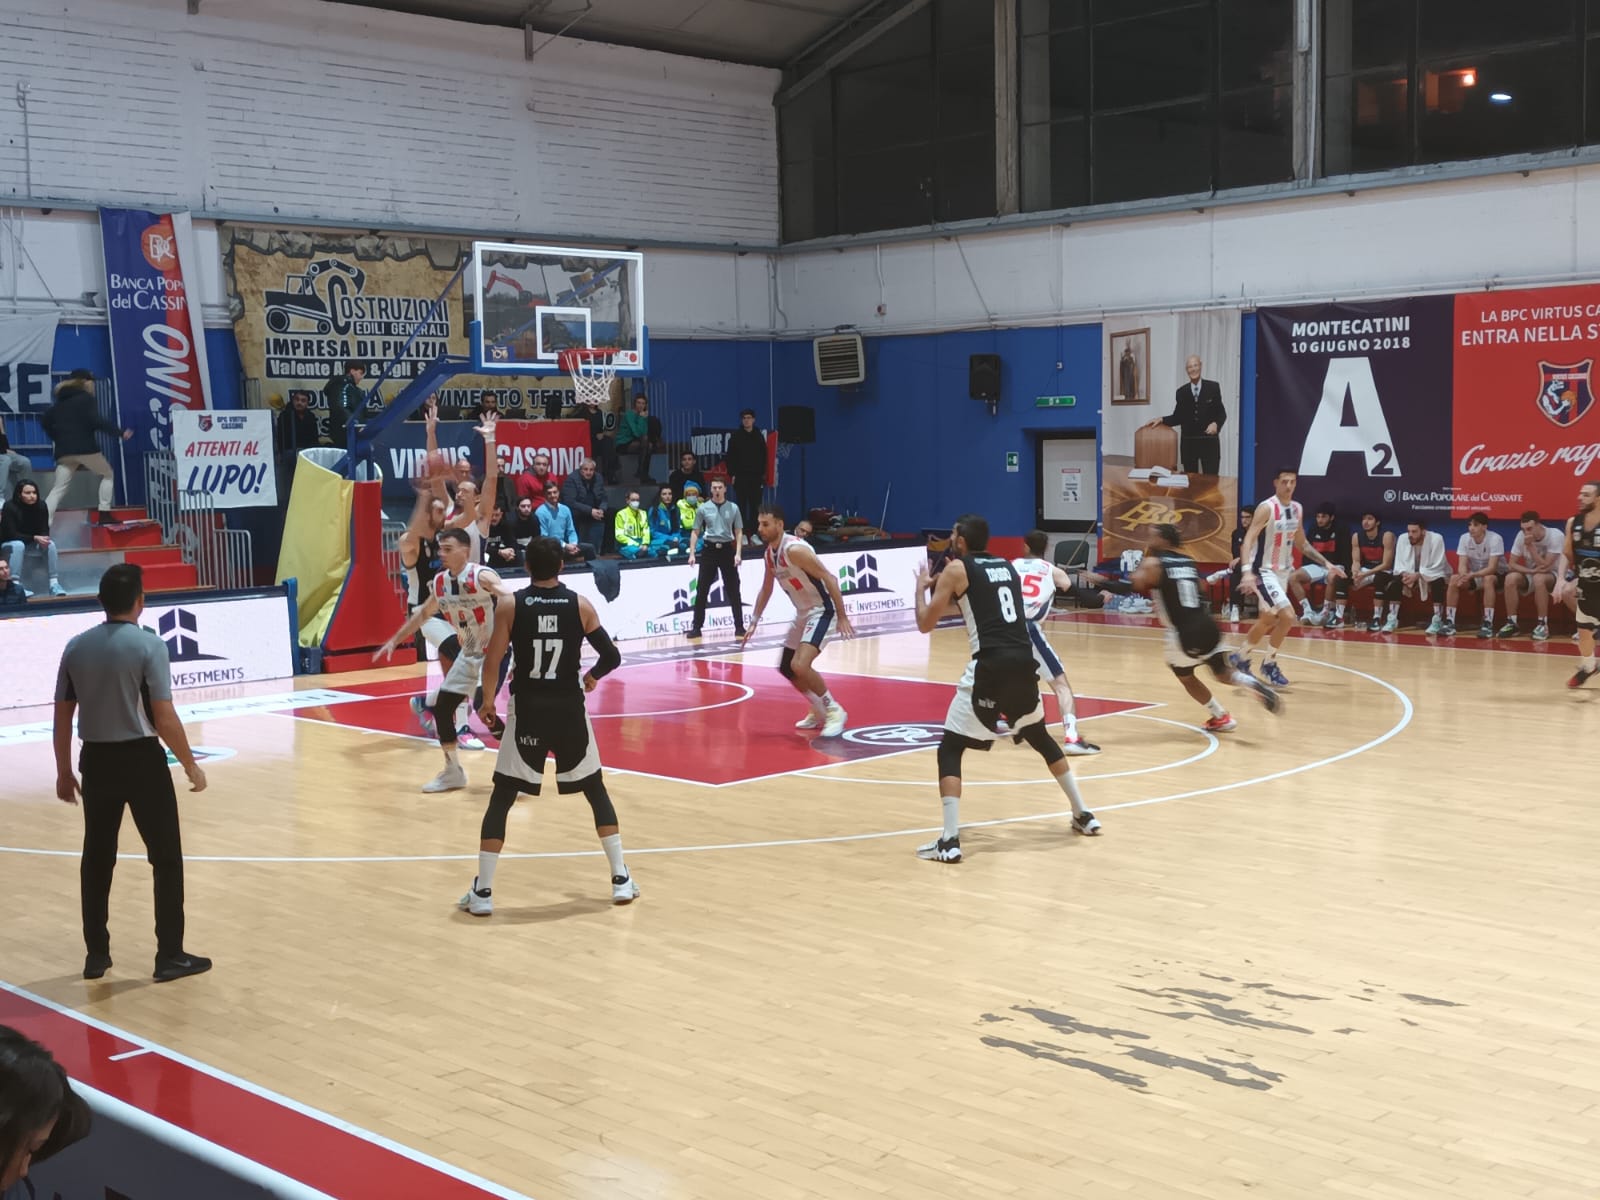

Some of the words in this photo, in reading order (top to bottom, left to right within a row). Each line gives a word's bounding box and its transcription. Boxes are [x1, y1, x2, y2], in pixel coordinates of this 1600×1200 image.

[110, 274, 154, 290] BANCA
[157, 276, 185, 290] POP
[112, 293, 132, 310] del
[328, 275, 449, 335] COSTRUZIONI
[1481, 311, 1498, 323] LA
[1501, 308, 1528, 322] BPC
[1531, 305, 1583, 320] VIRTUS
[355, 322, 385, 335] EDILI
[391, 323, 448, 336] GENERALI
[1292, 316, 1410, 337] MONTECATINI
[1461, 328, 1520, 346] ENTRA
[1524, 325, 1583, 343] NELLA
[1587, 323, 1600, 340] S
[266, 338, 350, 357] IMPRESA
[357, 340, 378, 358] DI
[382, 341, 449, 359] PULIZIA
[1292, 342, 1307, 354] 10
[1310, 338, 1370, 353] GIUGNO
[1374, 336, 1411, 350] 2018
[270, 360, 331, 376] Valente
[370, 360, 382, 375] &
[433, 388, 523, 409] VIMETO
[527, 388, 577, 408] TERR
[185, 441, 241, 457] ATTENTI
[243, 440, 260, 456] AL
[691, 433, 723, 455] VIRTUS
[1460, 444, 1549, 475] Grazie
[1550, 443, 1600, 476] rag
[187, 462, 267, 496] LUPO!
[1402, 491, 1429, 501] BANCA
[1430, 491, 1470, 502] POPOLARE
[1470, 493, 1480, 501] del
[1481, 491, 1524, 502] CASSINATE
[1022, 574, 1042, 599] 5
[856, 598, 905, 612] INVESTMENTS
[998, 586, 1018, 623] 8
[537, 615, 559, 633] MEI
[646, 620, 668, 634] REAL
[529, 638, 563, 680] 17
[171, 667, 245, 686] VESTMENTS
